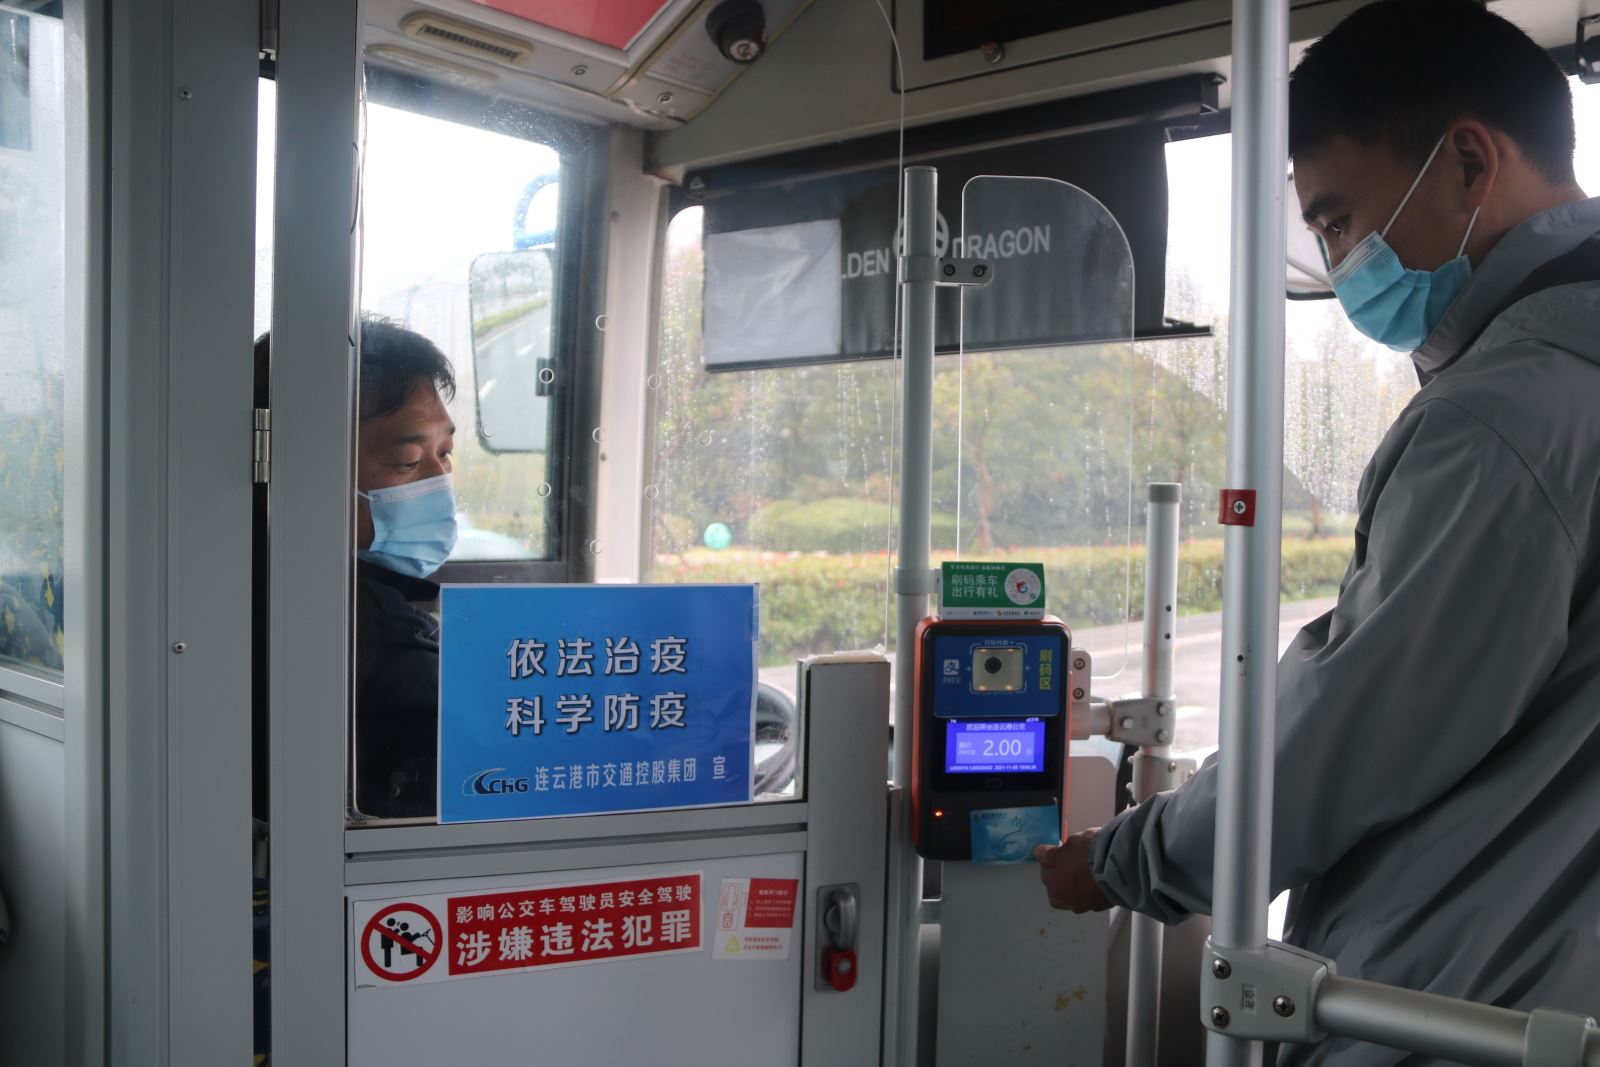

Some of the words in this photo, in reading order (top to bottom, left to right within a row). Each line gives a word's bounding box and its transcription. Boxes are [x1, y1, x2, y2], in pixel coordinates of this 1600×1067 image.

[842, 248, 890, 279] DEN
[952, 224, 1050, 259] DRAGON
[951, 574, 999, 586] 刷码乘车
[951, 586, 999, 598] 出行有礼
[506, 635, 688, 679] 依法治疫
[505, 691, 688, 736] 科学防疫
[982, 739, 1022, 756] 2.00
[535, 757, 697, 792] 连云港市交通控股集团
[712, 755, 726, 780] 宣
[455, 883, 693, 924] 影响公交车驾驶员安全驾驶
[455, 909, 693, 967] 涉嫌违法犯罪
